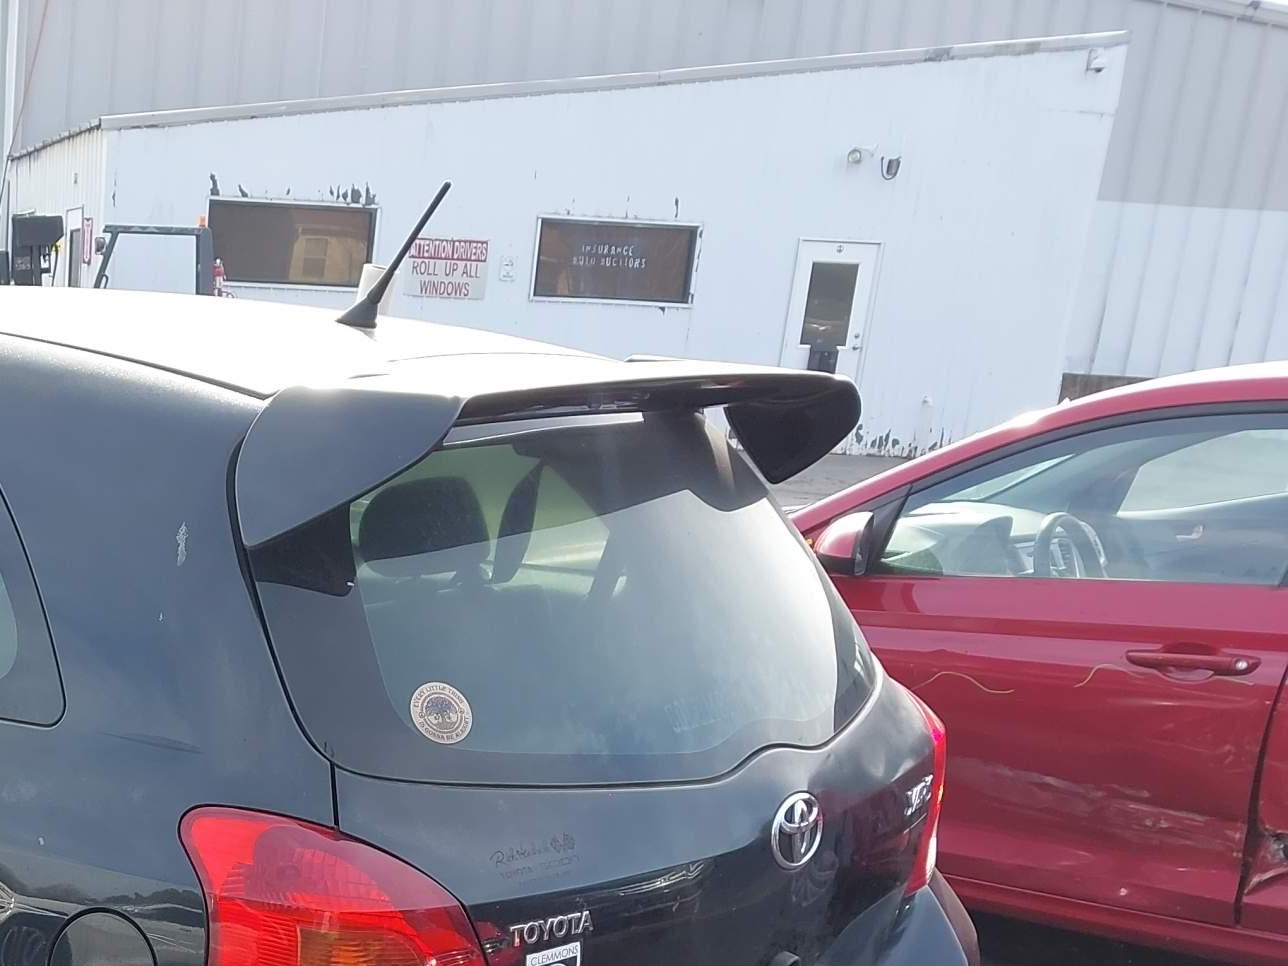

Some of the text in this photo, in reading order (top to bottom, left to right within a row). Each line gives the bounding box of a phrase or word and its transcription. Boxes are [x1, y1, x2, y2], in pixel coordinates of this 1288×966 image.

[410, 239, 487, 262] ATTENTION DRIVERS
[412, 260, 480, 278] ROLL UP ALL
[419, 279, 470, 297] WINDOWS
[510, 910, 593, 947] TOYOTA
[530, 944, 579, 966] CLEMMONS
